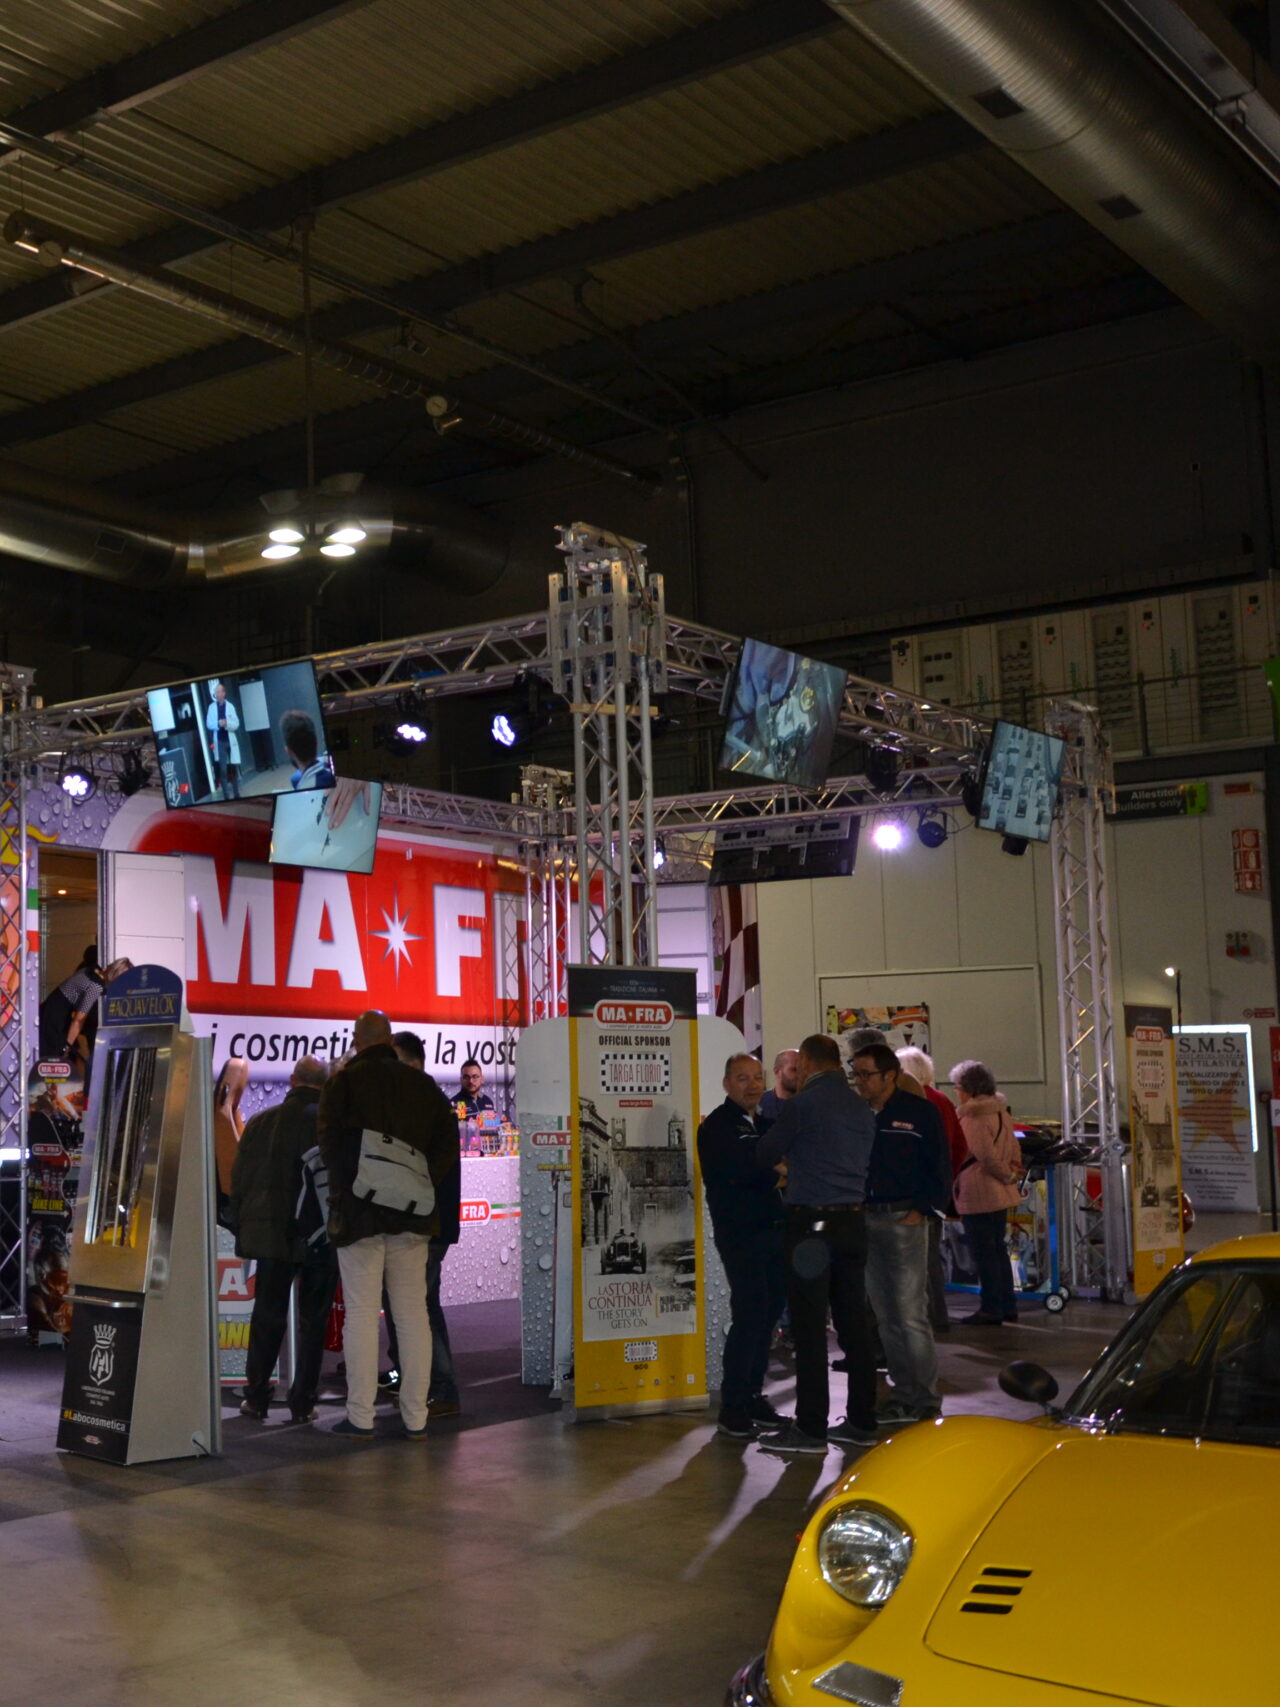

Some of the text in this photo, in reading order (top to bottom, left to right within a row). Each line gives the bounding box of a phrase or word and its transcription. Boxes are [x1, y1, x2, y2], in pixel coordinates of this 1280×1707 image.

[1159, 798, 1183, 808] only
[109, 996, 175, 1017] #AQUAVELOX
[229, 1027, 353, 1062] cosmeti
[434, 1032, 457, 1065] la
[599, 1035, 671, 1047] OFFICIAL SPONSOR
[1179, 1036, 1241, 1053] S.M.S.
[609, 1064, 661, 1083] TARGA FLORIO
[588, 1293, 652, 1311] CONTINUA
[598, 1308, 644, 1320] THE STORY
[611, 1318, 648, 1330] GETS ON
[63, 1409, 126, 1432] #Labocosmetica
